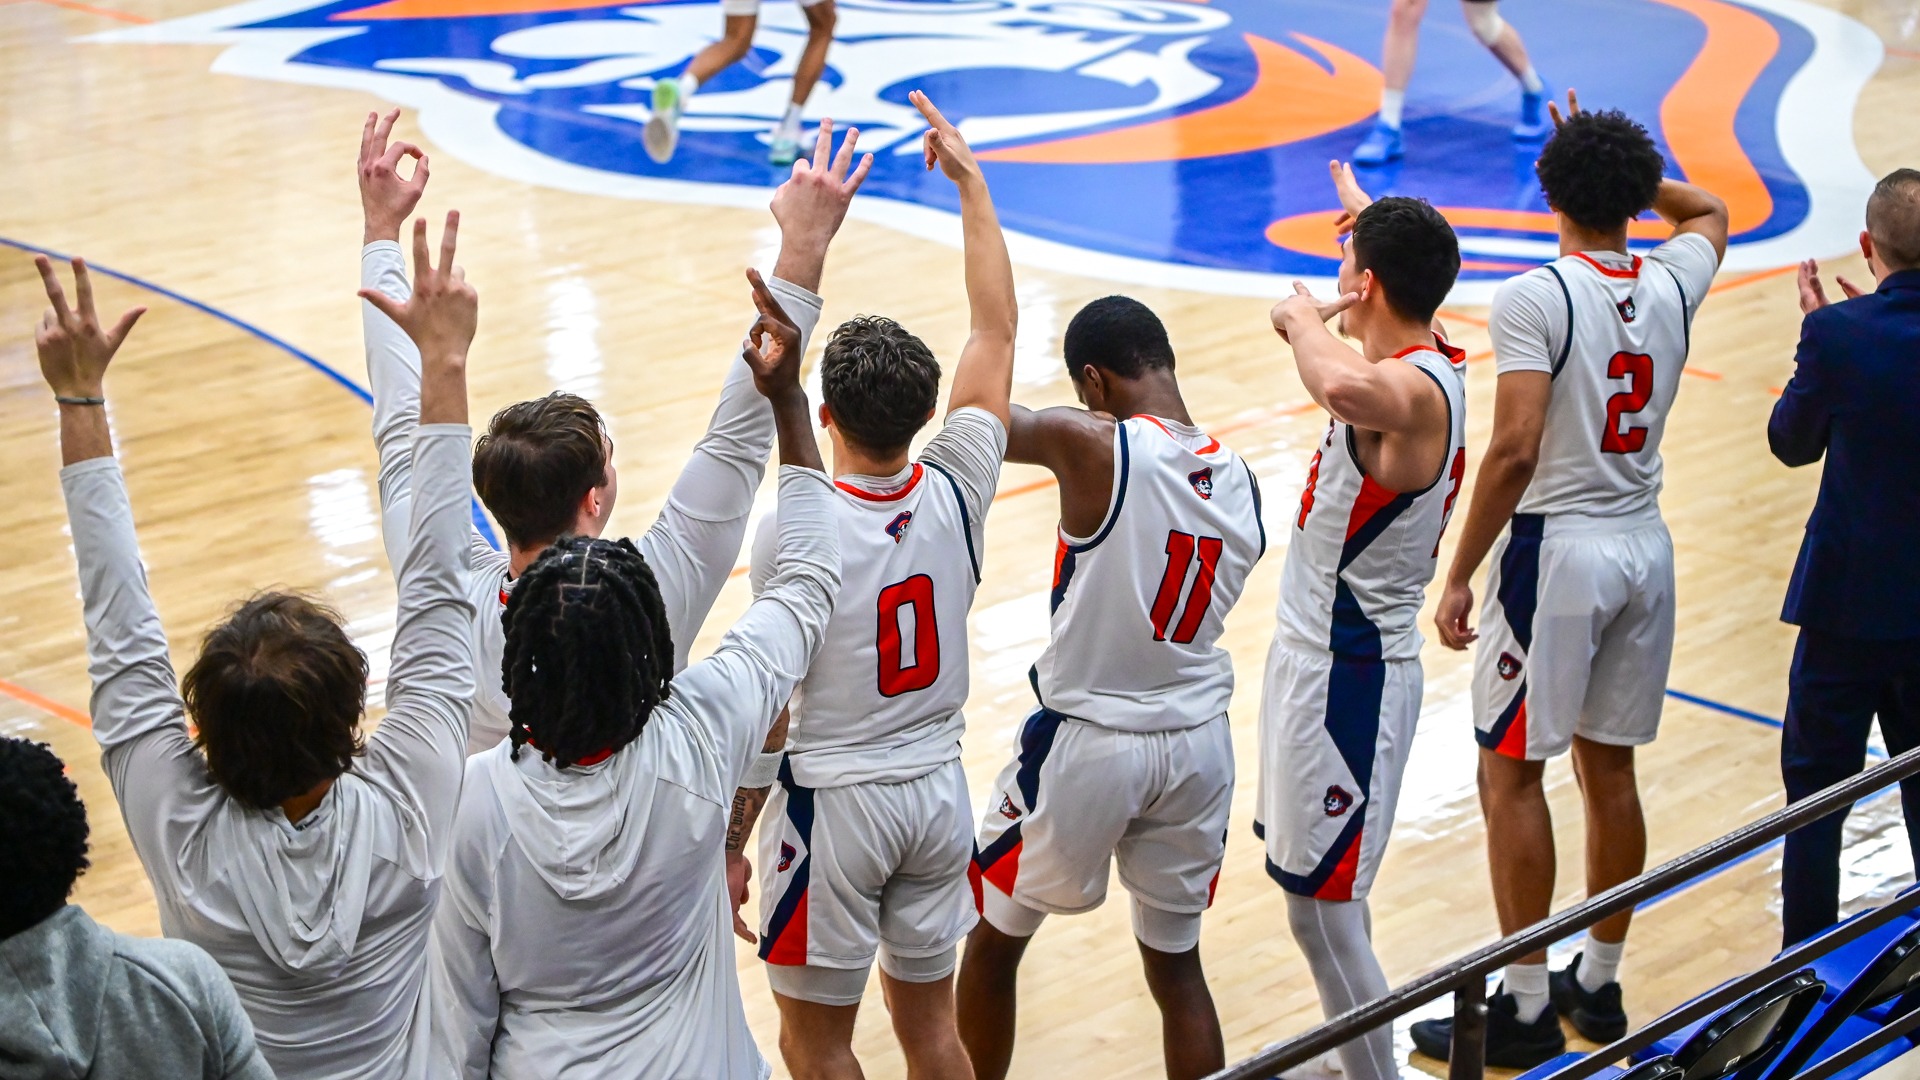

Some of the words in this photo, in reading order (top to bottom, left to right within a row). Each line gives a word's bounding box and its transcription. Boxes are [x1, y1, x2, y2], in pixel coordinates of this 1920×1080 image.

[1600, 351, 1653, 454] 2
[876, 573, 940, 698] 0
[1149, 529, 1223, 644] 11
[731, 794, 746, 826] world
